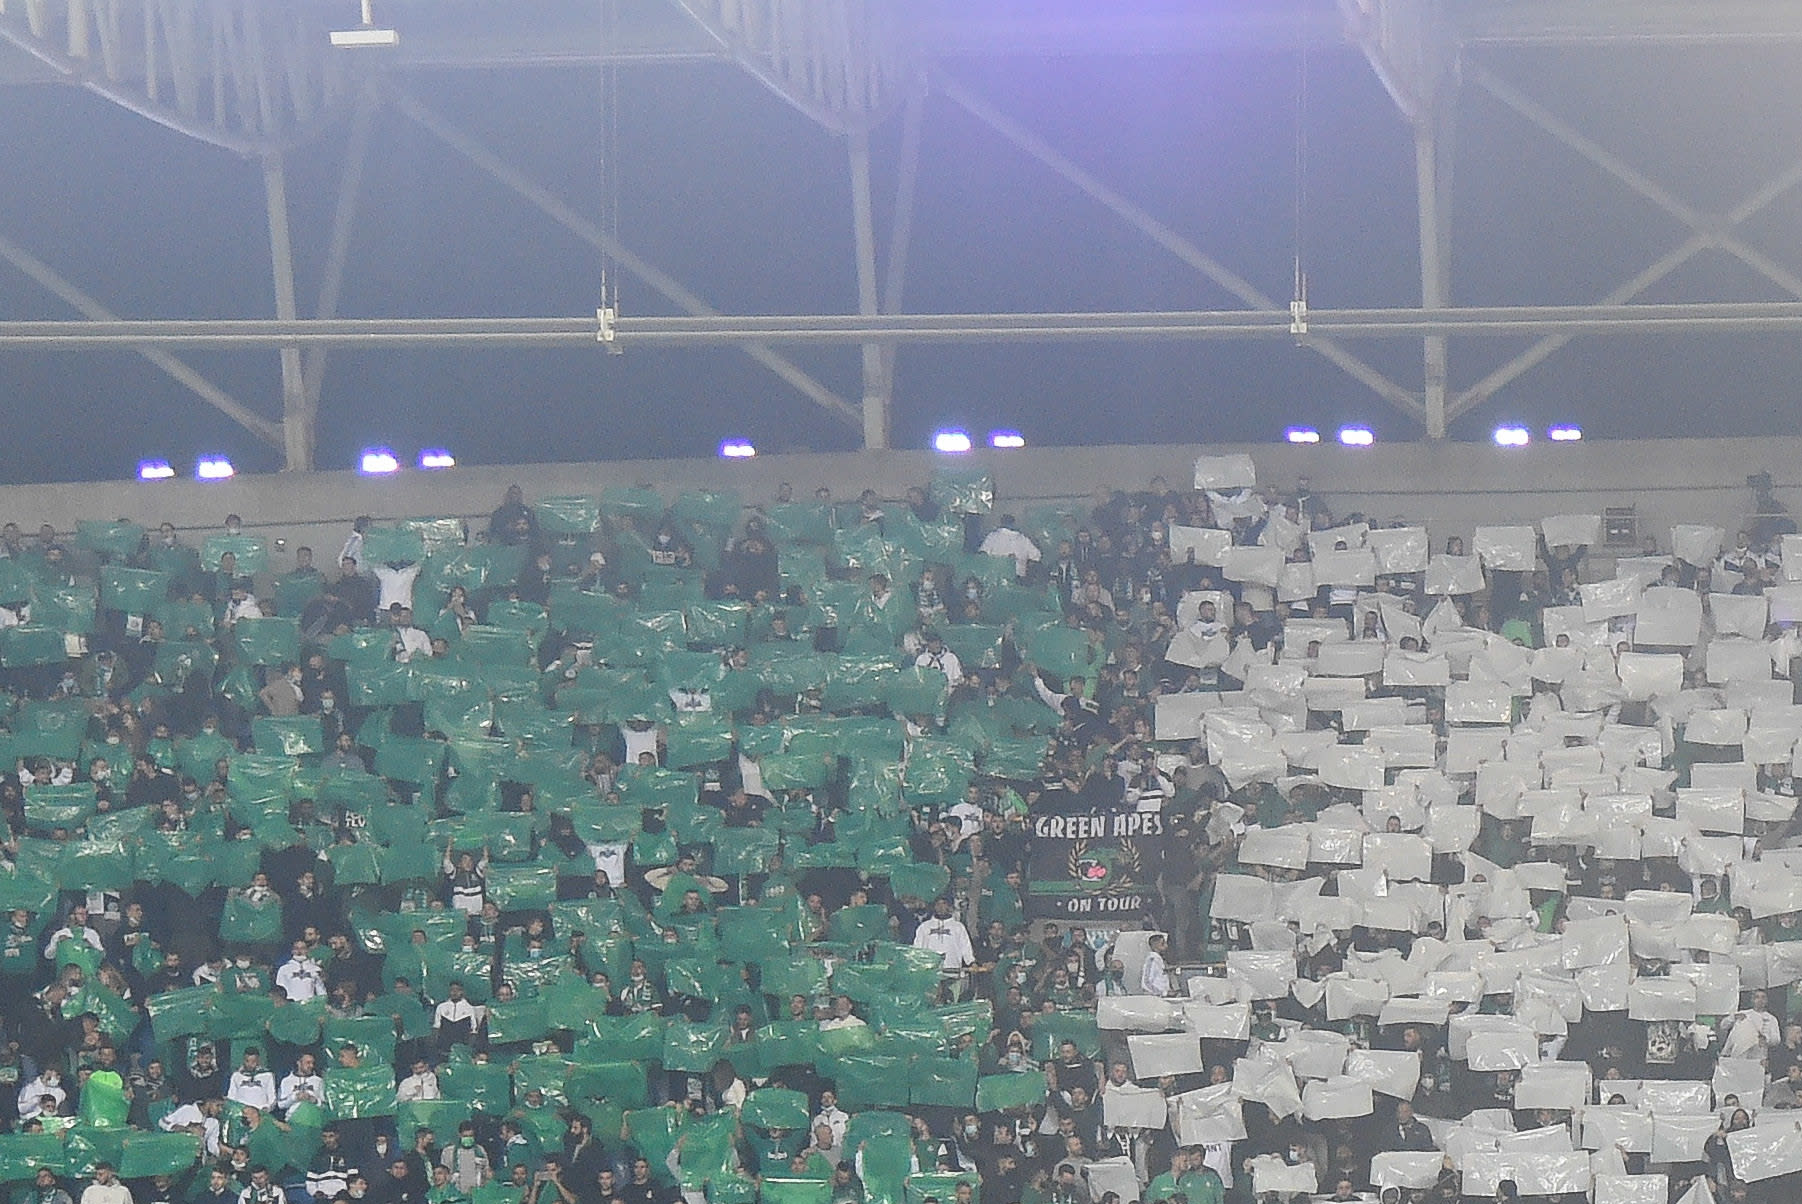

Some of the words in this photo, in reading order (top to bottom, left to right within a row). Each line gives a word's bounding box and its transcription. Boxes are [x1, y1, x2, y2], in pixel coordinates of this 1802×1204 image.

[1035, 815, 1106, 839] GREEN
[1113, 812, 1163, 837] APES
[1067, 898, 1091, 912] ON
[1098, 895, 1142, 912] TOUR
